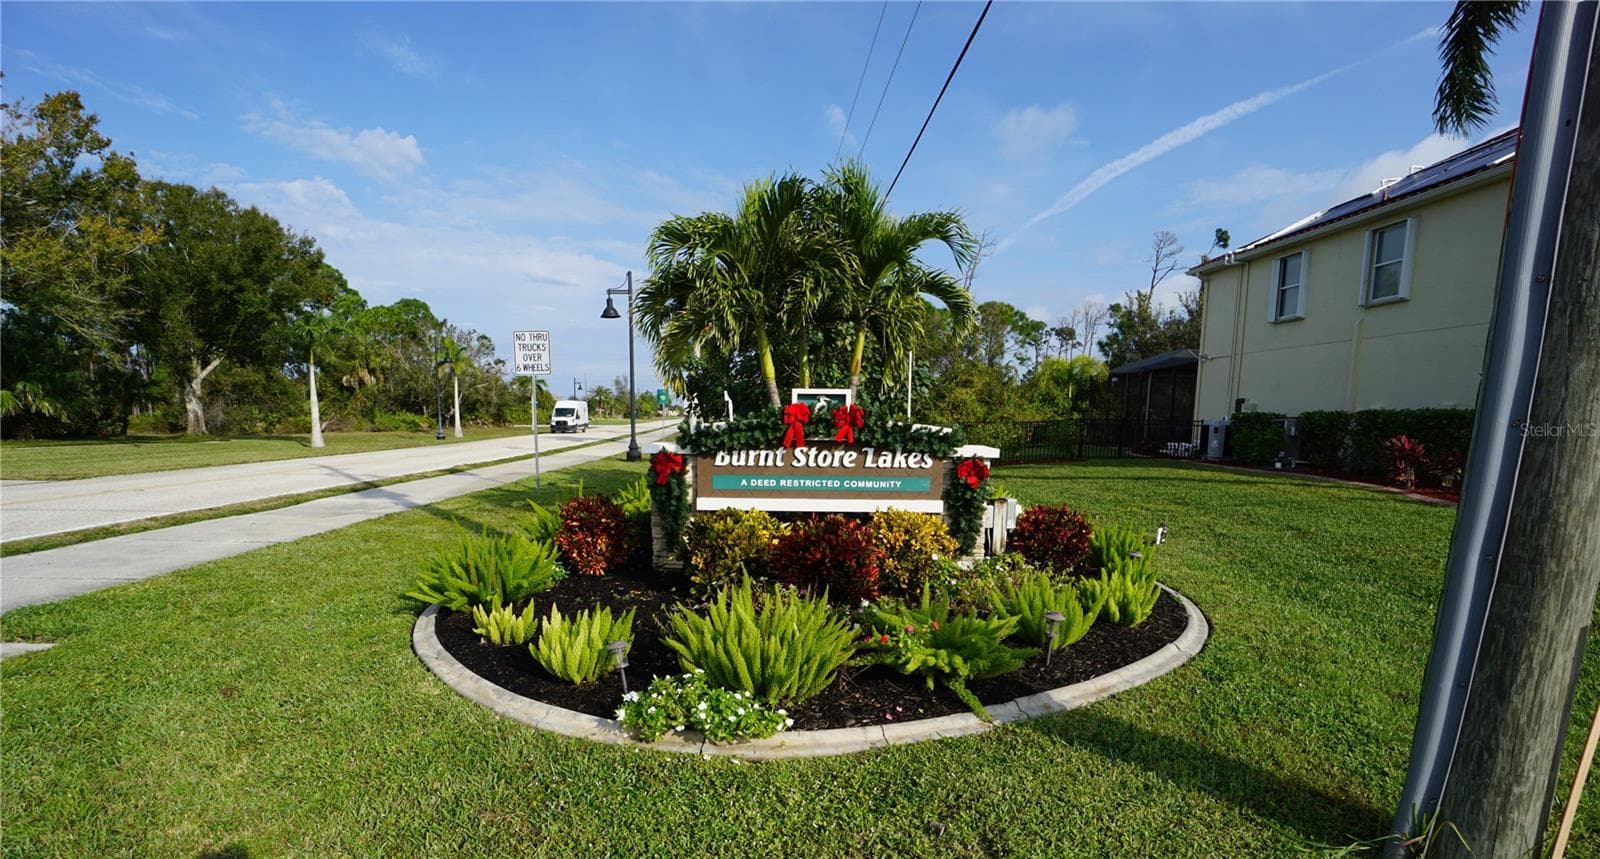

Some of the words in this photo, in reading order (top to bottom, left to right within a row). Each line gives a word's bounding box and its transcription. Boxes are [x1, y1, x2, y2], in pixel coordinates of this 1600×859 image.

[515, 333, 526, 342] NO
[529, 333, 548, 342] THRU
[518, 343, 547, 352] TRUCKS
[523, 353, 543, 362] OVER
[516, 363, 522, 372] 6
[523, 363, 550, 372] WHEELS
[791, 446, 856, 468] Store
[862, 446, 933, 469] Lakes
[740, 479, 748, 487] A
[750, 479, 777, 487] DEED
[780, 479, 841, 488] RESTRICTED
[844, 480, 903, 488] COMMUNITY
